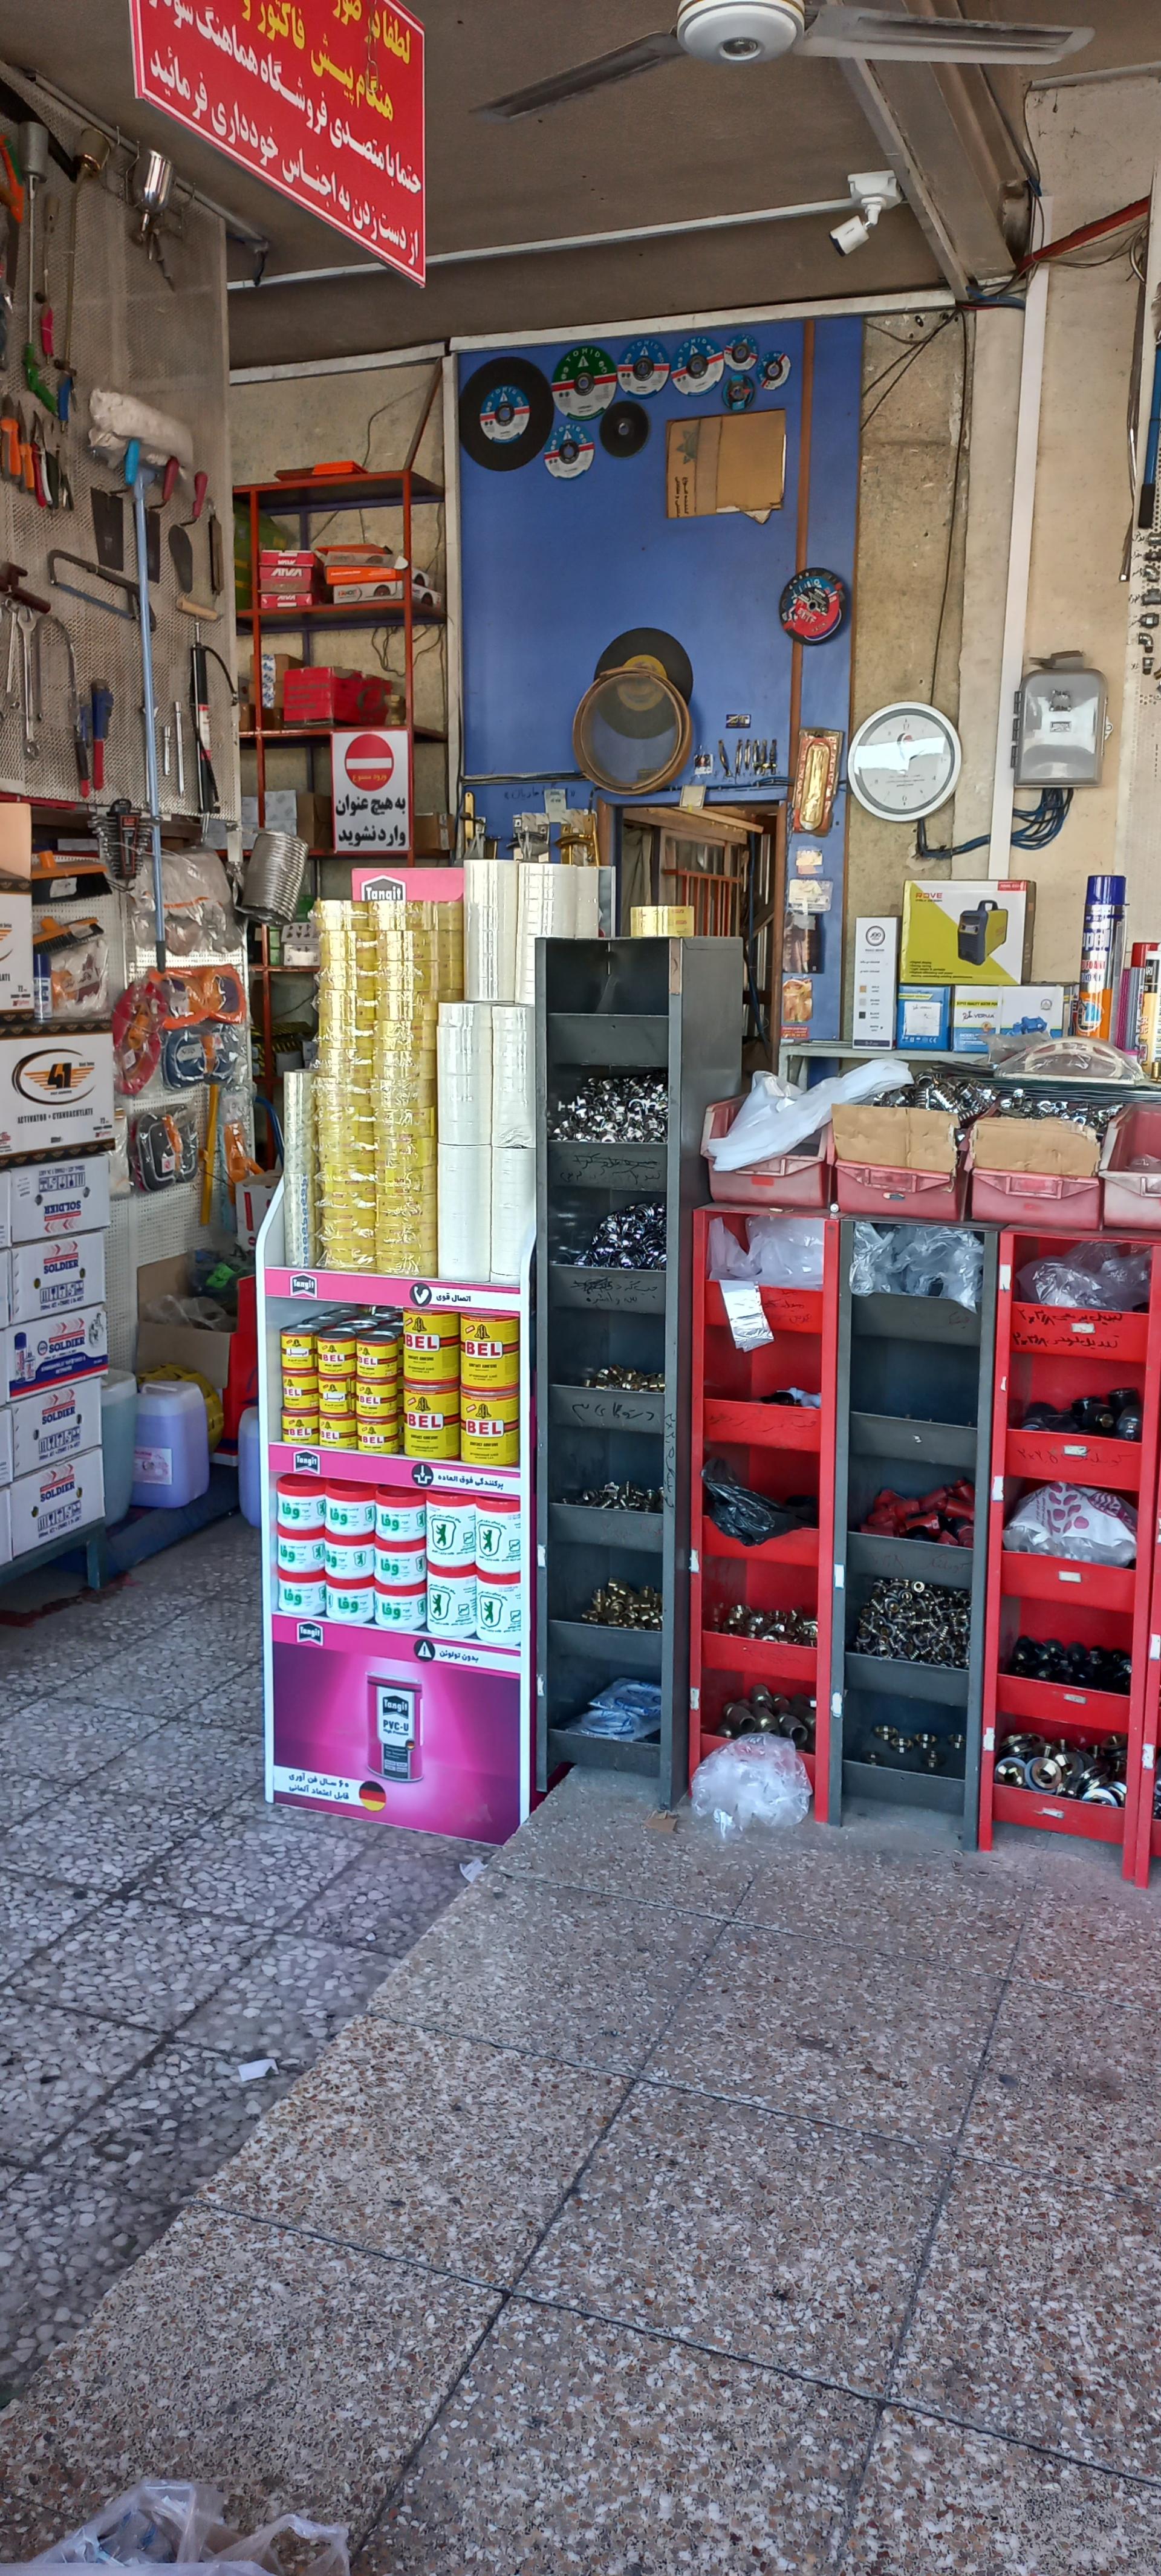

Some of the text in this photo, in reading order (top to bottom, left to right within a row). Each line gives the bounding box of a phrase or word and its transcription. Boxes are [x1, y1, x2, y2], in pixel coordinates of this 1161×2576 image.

[333, 0, 362, 25] صور
[258, 0, 305, 50] فاکتور
[196, 7, 258, 76] هماهنگ
[383, 10, 411, 64] لطفا
[311, 33, 354, 106] پیش
[261, 52, 327, 134] فروشگاه
[356, 67, 394, 122] هنگام
[330, 118, 385, 171] متصدی
[151, 46, 419, 265] از دست زدن به اجناس خودداری فرمائید
[386, 144, 394, 187] با
[396, 151, 421, 194] حتما
[565, 348, 600, 363] TOHID
[336, 794, 406, 816] به هیچ عنوان
[338, 825, 406, 847] وارد نشوید
[365, 885, 402, 900] Tangit
[47, 1062, 72, 1089] 41
[18, 1113, 47, 1124] ACTIVATOR
[44, 1200, 81, 1215] SOLDIER
[44, 1259, 79, 1274] SOLDIER
[293, 1278, 314, 1290] Tangit
[436, 1292, 471, 1303] اتصال قوی
[49, 1336, 85, 1353] SOLDIER
[406, 1334, 438, 1350] BEL
[467, 1341, 501, 1356] BEL
[359, 1396, 379, 1404] BEL
[42, 1406, 76, 1425] SOLDIER
[409, 1413, 441, 1428] BEL
[321, 1431, 338, 1440] BEL
[467, 1420, 501, 1435] BEL
[296, 1455, 317, 1467] Tangit
[460, 1475, 473, 1485] فوق
[475, 1477, 504, 1490] پرکنندگی
[41, 1482, 75, 1503] SOLDIER
[282, 1501, 300, 1519] وفا
[330, 1506, 348, 1525] وفا
[380, 1512, 399, 1531] وفا
[280, 1544, 295, 1563] وفا
[326, 1549, 337, 1568] وف
[380, 1558, 399, 1576] وفا
[284, 1588, 302, 1605] وفا
[337, 1597, 359, 1613] وفا
[382, 1601, 401, 1619] وفا
[299, 1626, 321, 1640] Tangit
[439, 1649, 479, 1663] بدون تولوئن
[384, 1699, 408, 1712] Tangit
[383, 1719, 409, 1732] PVC-U
[288, 1772, 305, 1782] آوری
[311, 1788, 332, 1797] اعتماد
